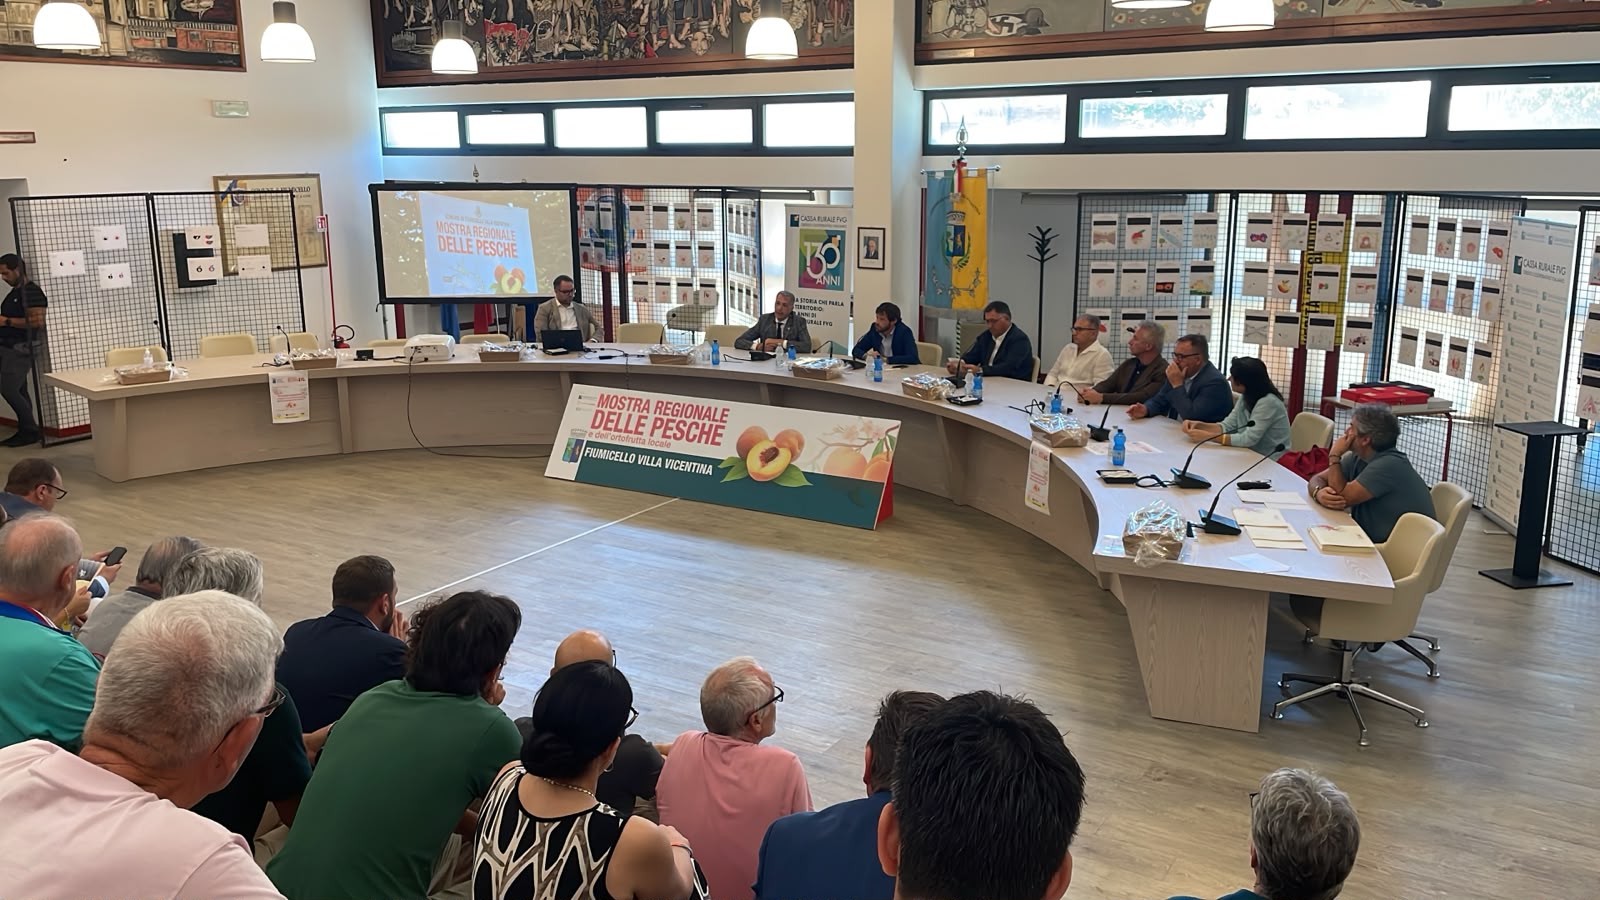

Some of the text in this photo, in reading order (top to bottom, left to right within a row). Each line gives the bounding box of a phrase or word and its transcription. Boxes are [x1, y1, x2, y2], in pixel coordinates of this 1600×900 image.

[436, 220, 516, 241] MOSTRA REGIONALE
[438, 235, 518, 258] DELLE PESCHE
[816, 275, 840, 286] ANNI
[597, 394, 650, 414] MOSTRA
[654, 400, 730, 423] REGIONALE
[591, 410, 725, 446] DELLE PESCHE
[648, 438, 672, 448] locale
[584, 447, 713, 475] FIUMICELLO VILLA VICENTINA
